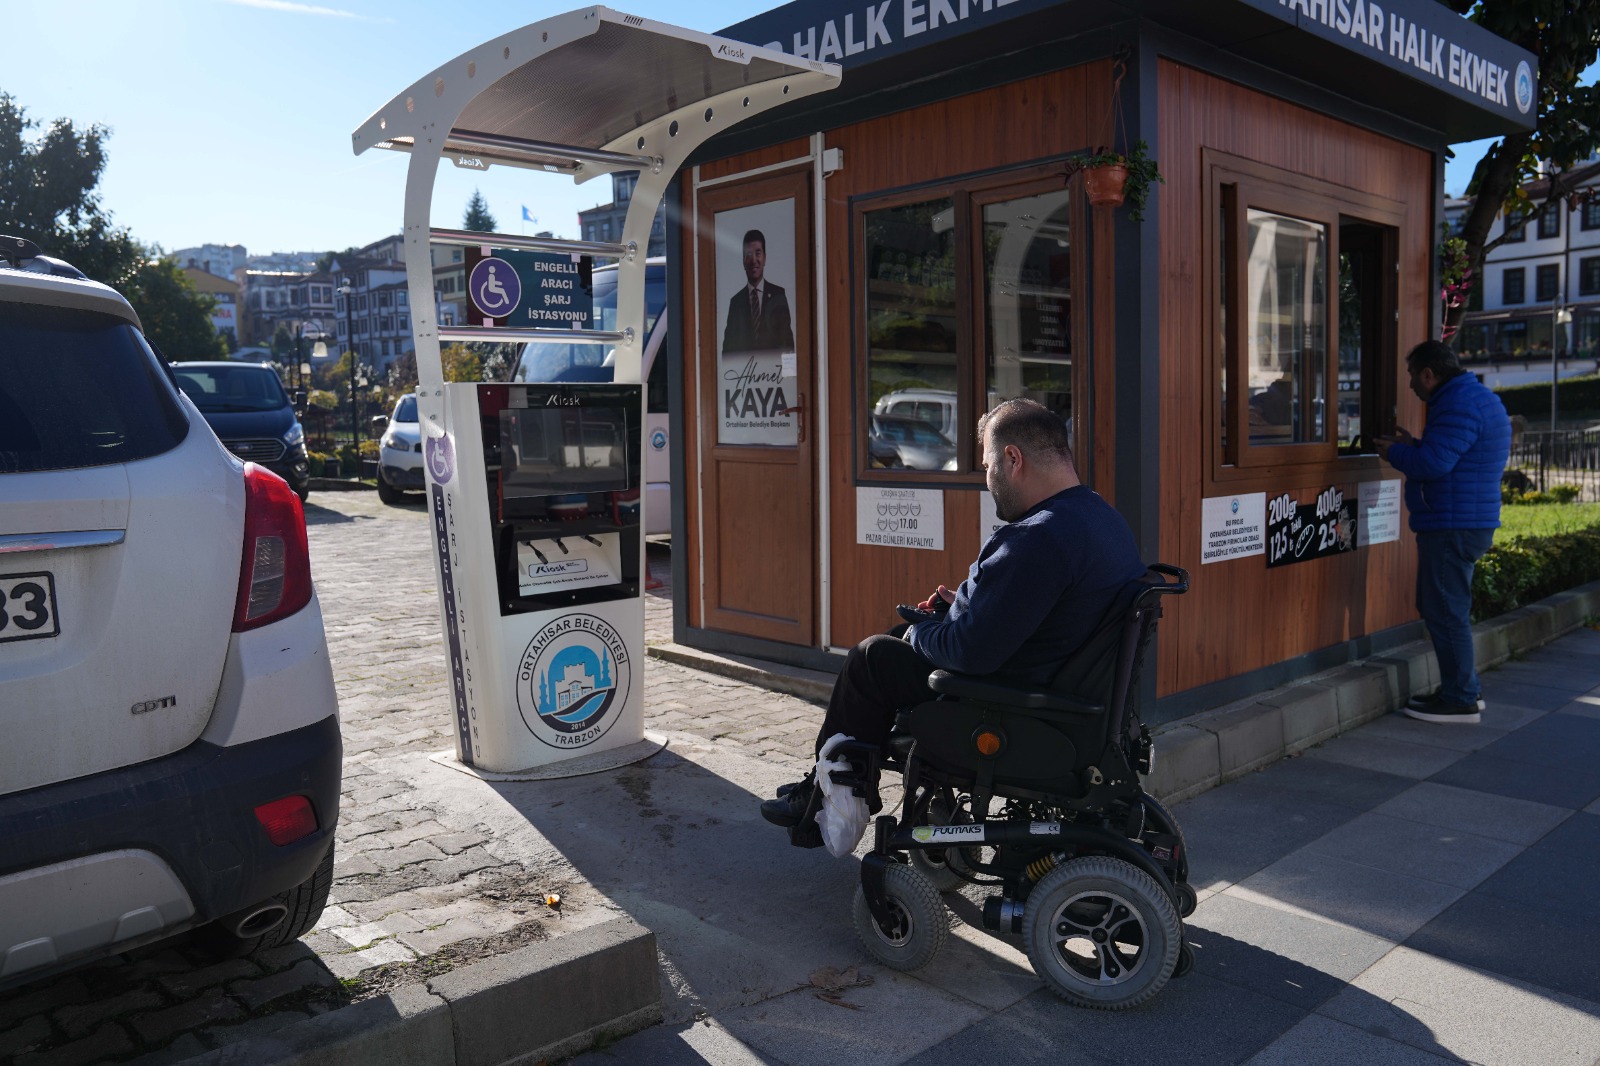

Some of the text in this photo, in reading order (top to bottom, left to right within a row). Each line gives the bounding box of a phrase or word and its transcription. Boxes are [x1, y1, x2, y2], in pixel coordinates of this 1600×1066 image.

[793, 0, 1019, 62] HALK EK
[718, 44, 745, 59] Kiosk
[1390, 13, 1444, 78] HALK
[1449, 44, 1508, 106] EKMEK
[534, 261, 579, 274] ENGELLİ
[541, 278, 573, 290] ARACI
[544, 295, 571, 306] ŞARJ
[528, 307, 587, 321] İSTASYONU
[724, 355, 783, 398] Ahmet
[546, 394, 580, 406] Kiosk
[725, 387, 790, 418] KAYA
[1269, 493, 1297, 526] 200gr
[1316, 486, 1343, 519] 400gr
[900, 518, 918, 529] 17.00
[866, 533, 934, 548] PAZAR GÜNLERİ KAPALIYIZ
[536, 564, 566, 574] Kiosk
[0, 582, 48, 632] 3
[521, 618, 627, 681] ORTAHİSAR BELEDİYESİ
[571, 721, 586, 731] 2014
[555, 725, 601, 744] TRABZON
